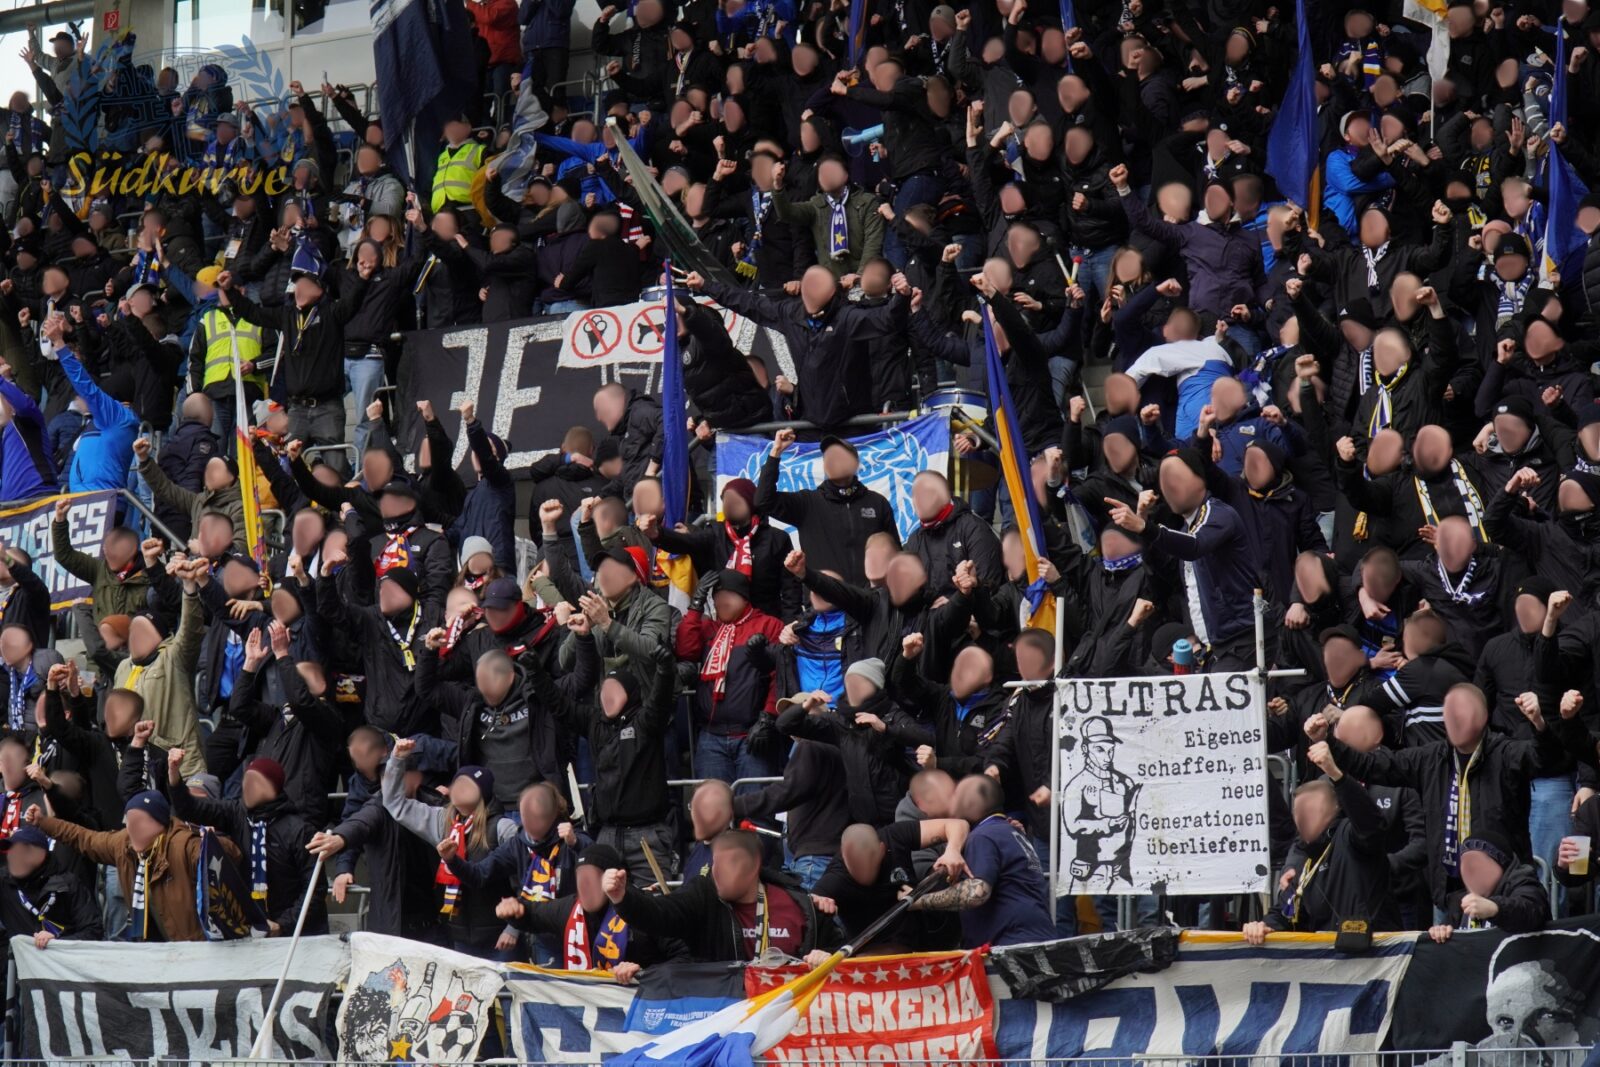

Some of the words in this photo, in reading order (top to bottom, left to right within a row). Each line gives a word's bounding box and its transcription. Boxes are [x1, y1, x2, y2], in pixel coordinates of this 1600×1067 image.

[1070, 674, 1251, 717] ULTRAS
[1184, 728, 1262, 750] Eigenes
[1138, 757, 1235, 777] schaffen,
[1222, 783, 1264, 800] neue
[1139, 810, 1266, 831] Generationen
[1147, 837, 1269, 855] überliefern.
[789, 976, 985, 1037] HICKERIA
[30, 987, 334, 1067] ULTRAS
